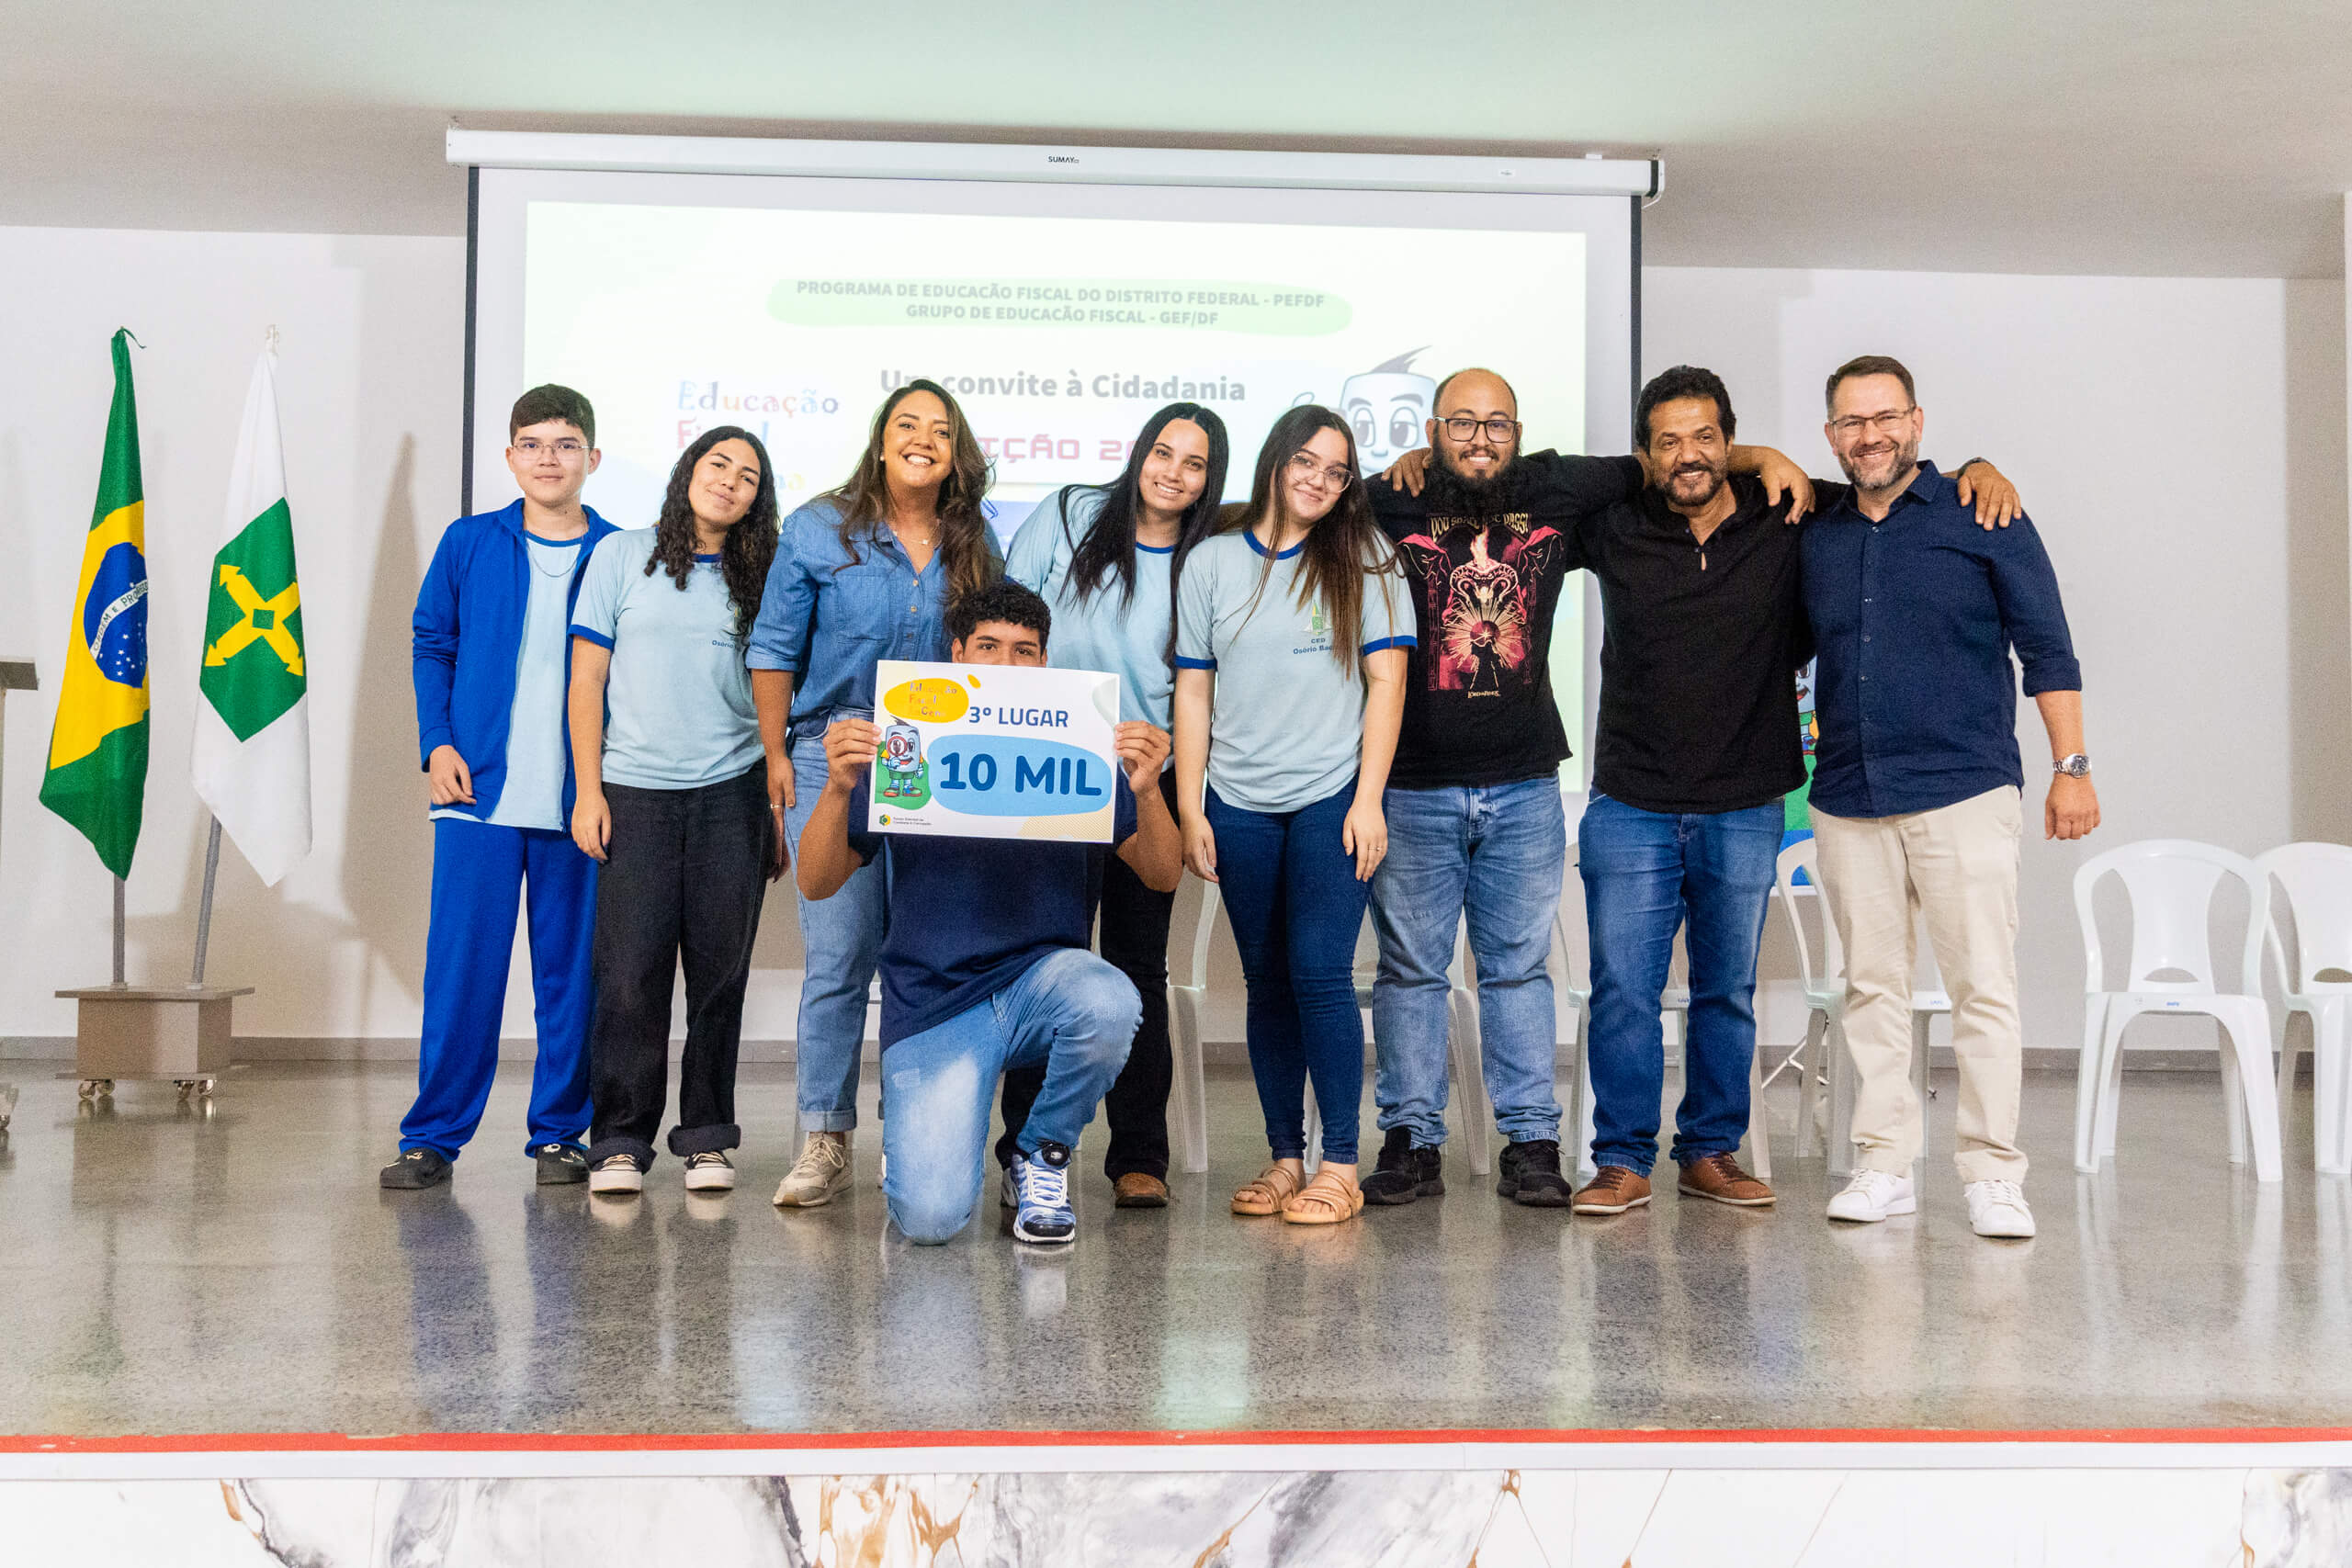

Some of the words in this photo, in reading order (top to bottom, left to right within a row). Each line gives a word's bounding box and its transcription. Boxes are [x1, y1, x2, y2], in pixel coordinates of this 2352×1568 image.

[797, 280, 893, 297] PROGRAMA
[898, 283, 919, 297] DE
[1016, 286, 1073, 301] FISCAL
[1078, 288, 1102, 303] DO
[1105, 288, 1183, 304] DISTRITO
[1187, 291, 1259, 307] FEDERAL
[1273, 293, 1325, 308] PEFDF
[907, 304, 967, 319] GRUPO
[969, 306, 991, 320] DE
[1089, 309, 1147, 323] FISCAL
[1159, 310, 1218, 329] GEF/DF
[677, 379, 840, 419] Educação
[942, 370, 1057, 398] convite
[1066, 367, 1083, 399] à
[1091, 372, 1246, 402] Cidadania
[998, 706, 1069, 728] LUGAR
[940, 751, 998, 792] 10
[1014, 754, 1102, 796] MIL
